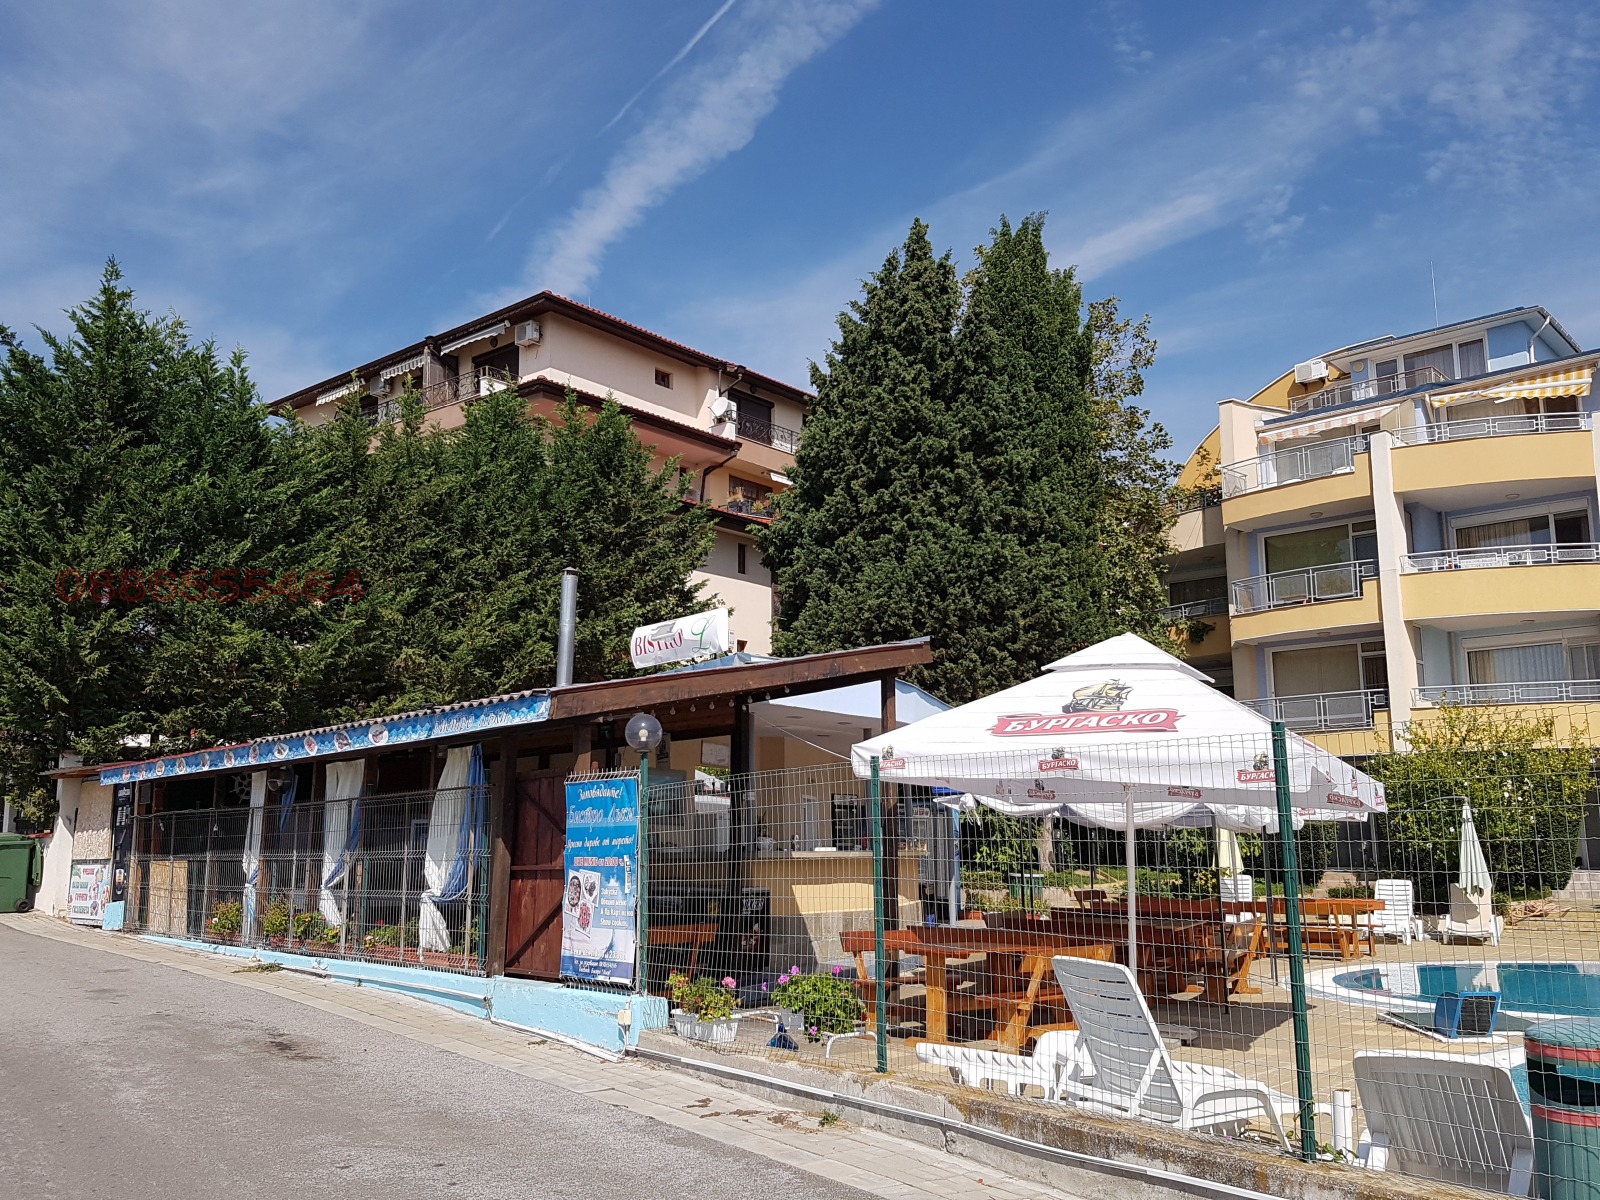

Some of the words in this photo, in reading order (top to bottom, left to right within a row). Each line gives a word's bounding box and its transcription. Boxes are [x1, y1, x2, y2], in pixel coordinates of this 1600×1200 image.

[1003, 712, 1168, 732] БУРГАСКО
[1041, 759, 1077, 770] БУРГАСКО
[1240, 771, 1275, 781] БУРГАСК
